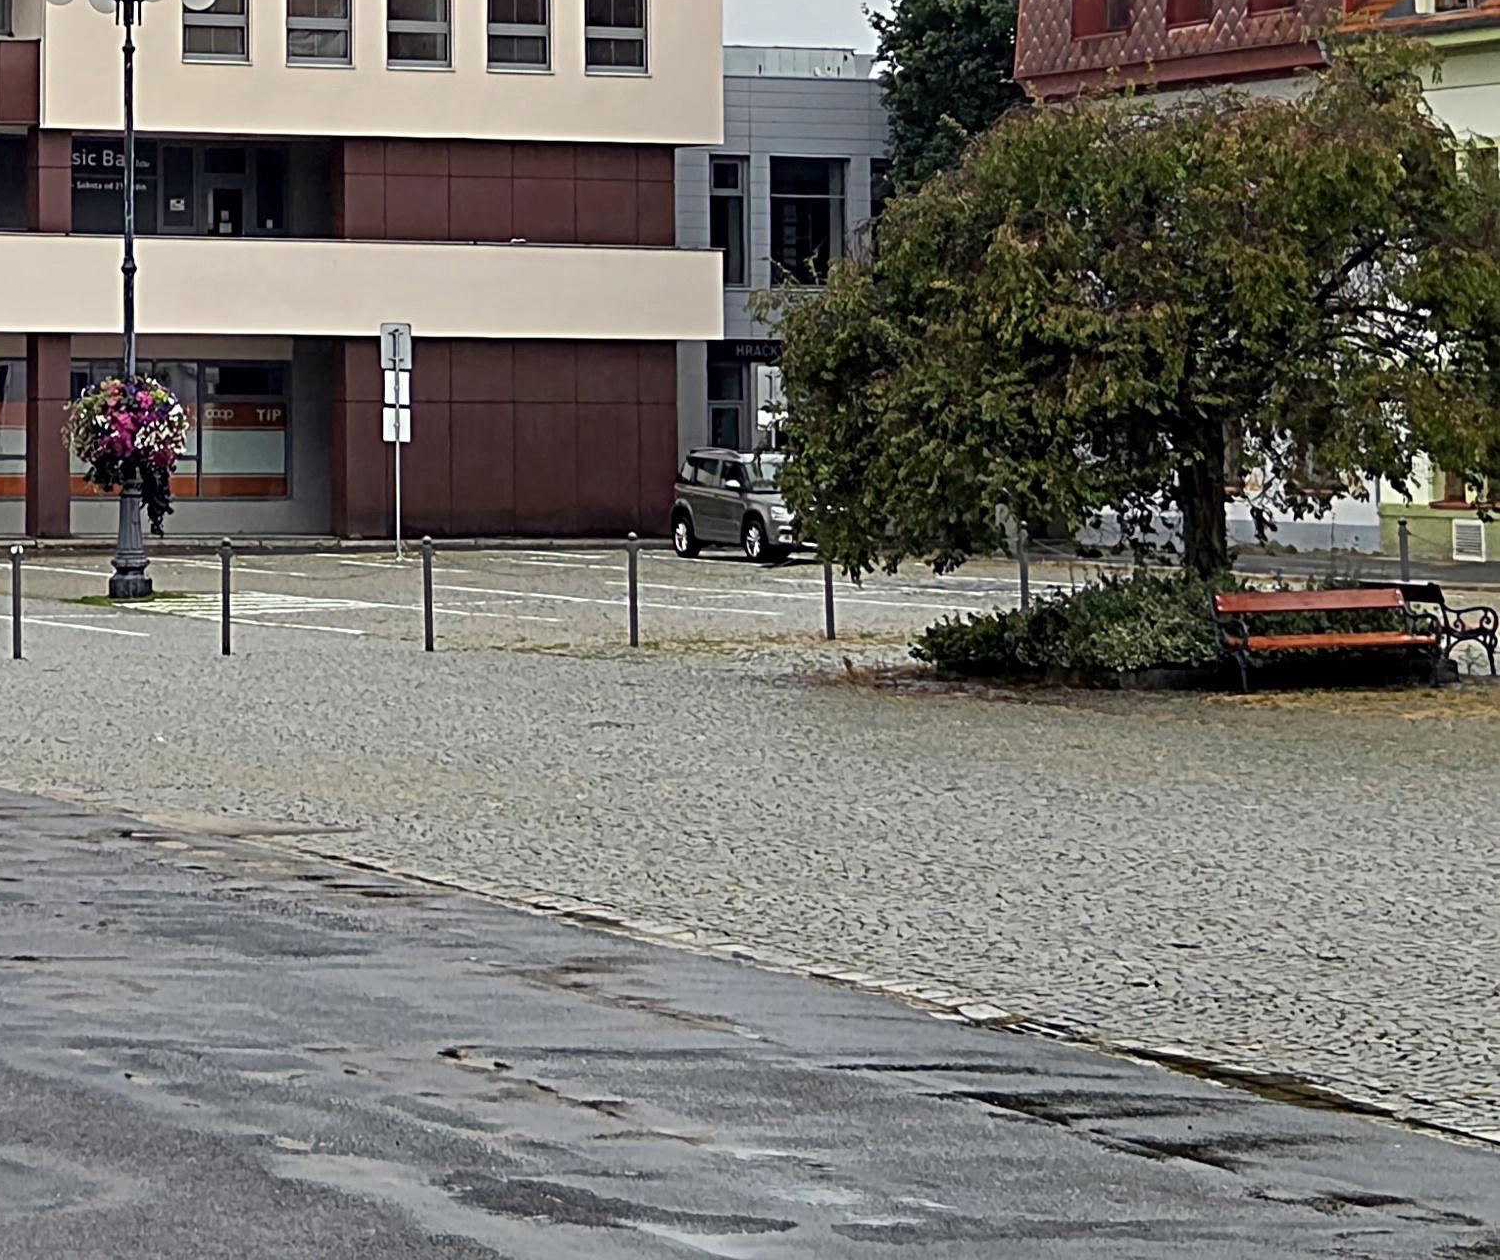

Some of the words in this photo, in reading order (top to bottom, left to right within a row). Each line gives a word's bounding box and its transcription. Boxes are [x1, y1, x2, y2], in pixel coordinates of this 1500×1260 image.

[71, 148, 97, 166] sic
[102, 149, 126, 167] Ba
[736, 342, 782, 357] HRAČK
[256, 408, 282, 422] TIP
